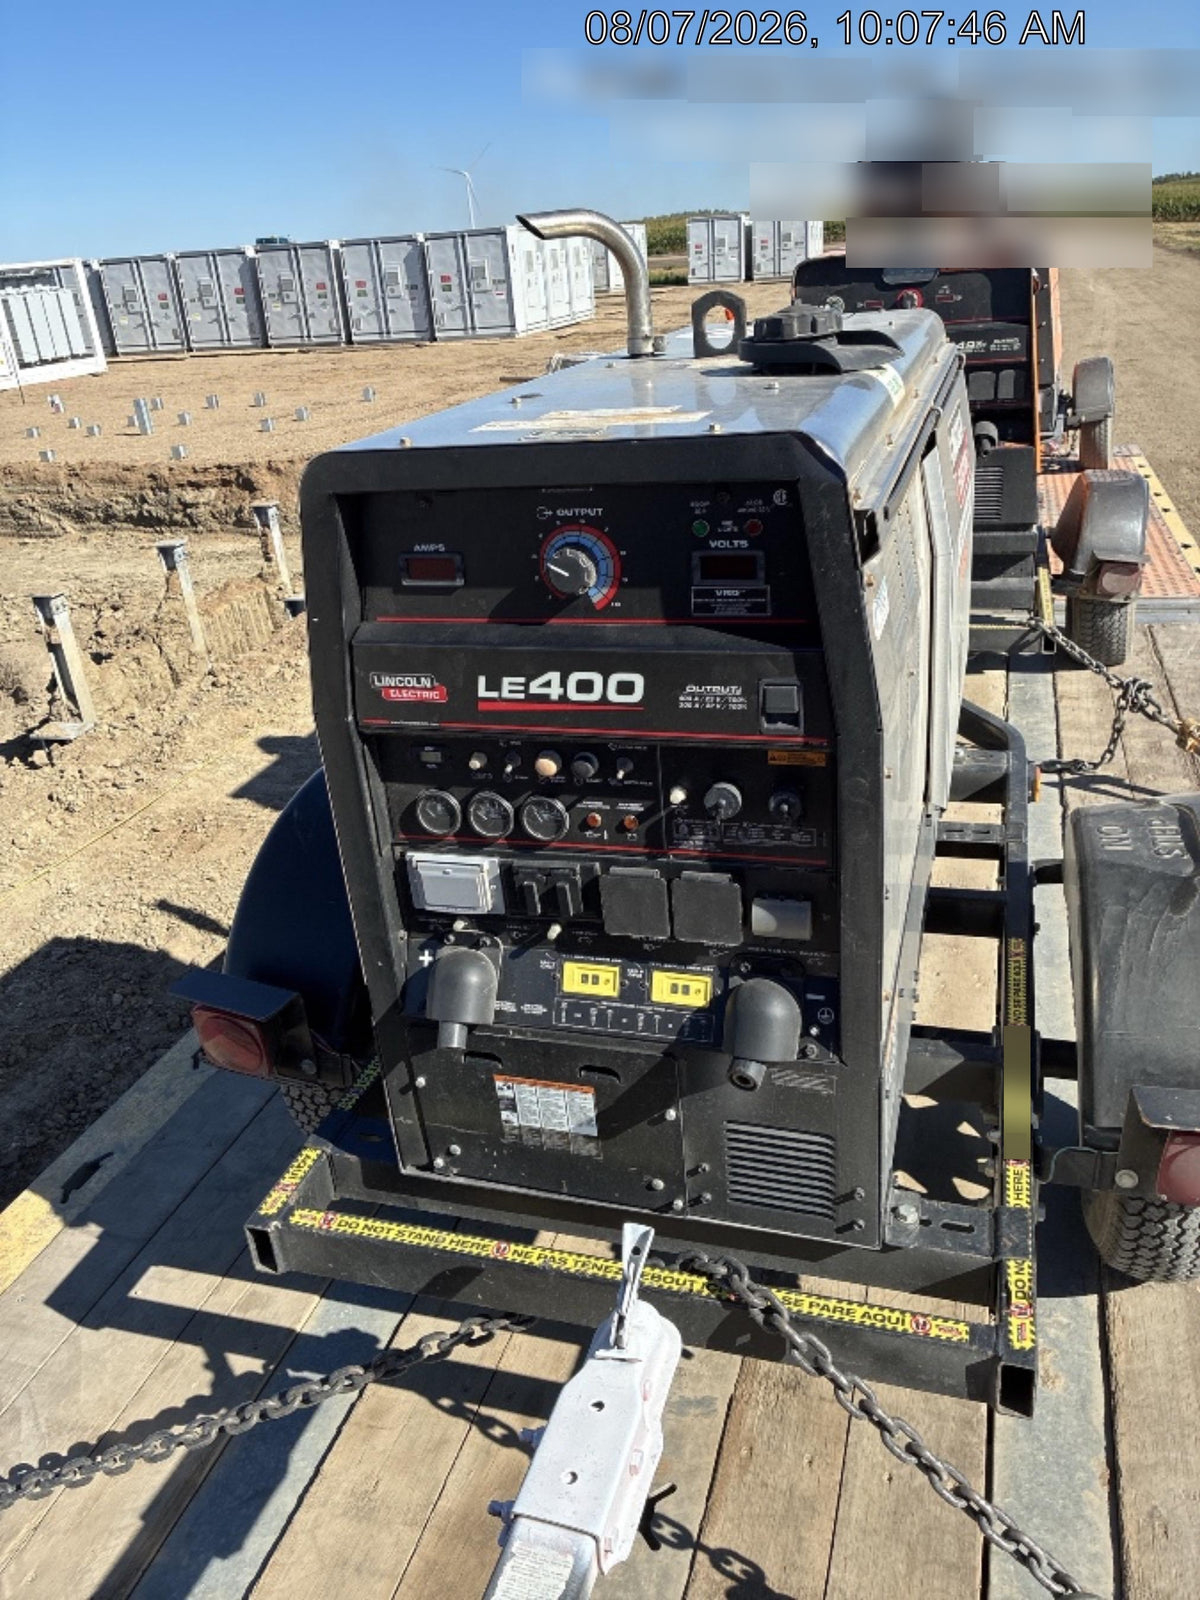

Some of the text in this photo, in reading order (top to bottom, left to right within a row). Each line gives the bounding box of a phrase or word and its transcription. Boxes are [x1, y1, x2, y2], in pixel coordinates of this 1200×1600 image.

[556, 508, 604, 516] OUTPUT
[413, 543, 446, 552] AMPS
[709, 540, 749, 548] VOLTS
[373, 674, 433, 688] LINCOLN
[477, 671, 645, 703] LE400
[685, 684, 740, 694] OUTPUT
[389, 688, 440, 700] ELECTRIC
[1013, 1169, 1024, 1201] HERE
[336, 1219, 492, 1252] DO NOT STAND HERE
[511, 1248, 531, 1260] NE
[536, 1253, 569, 1267] PAS
[642, 1272, 698, 1290] EBOUT
[1014, 1278, 1027, 1301] DO
[781, 1294, 907, 1327] SE PARE AQUI
